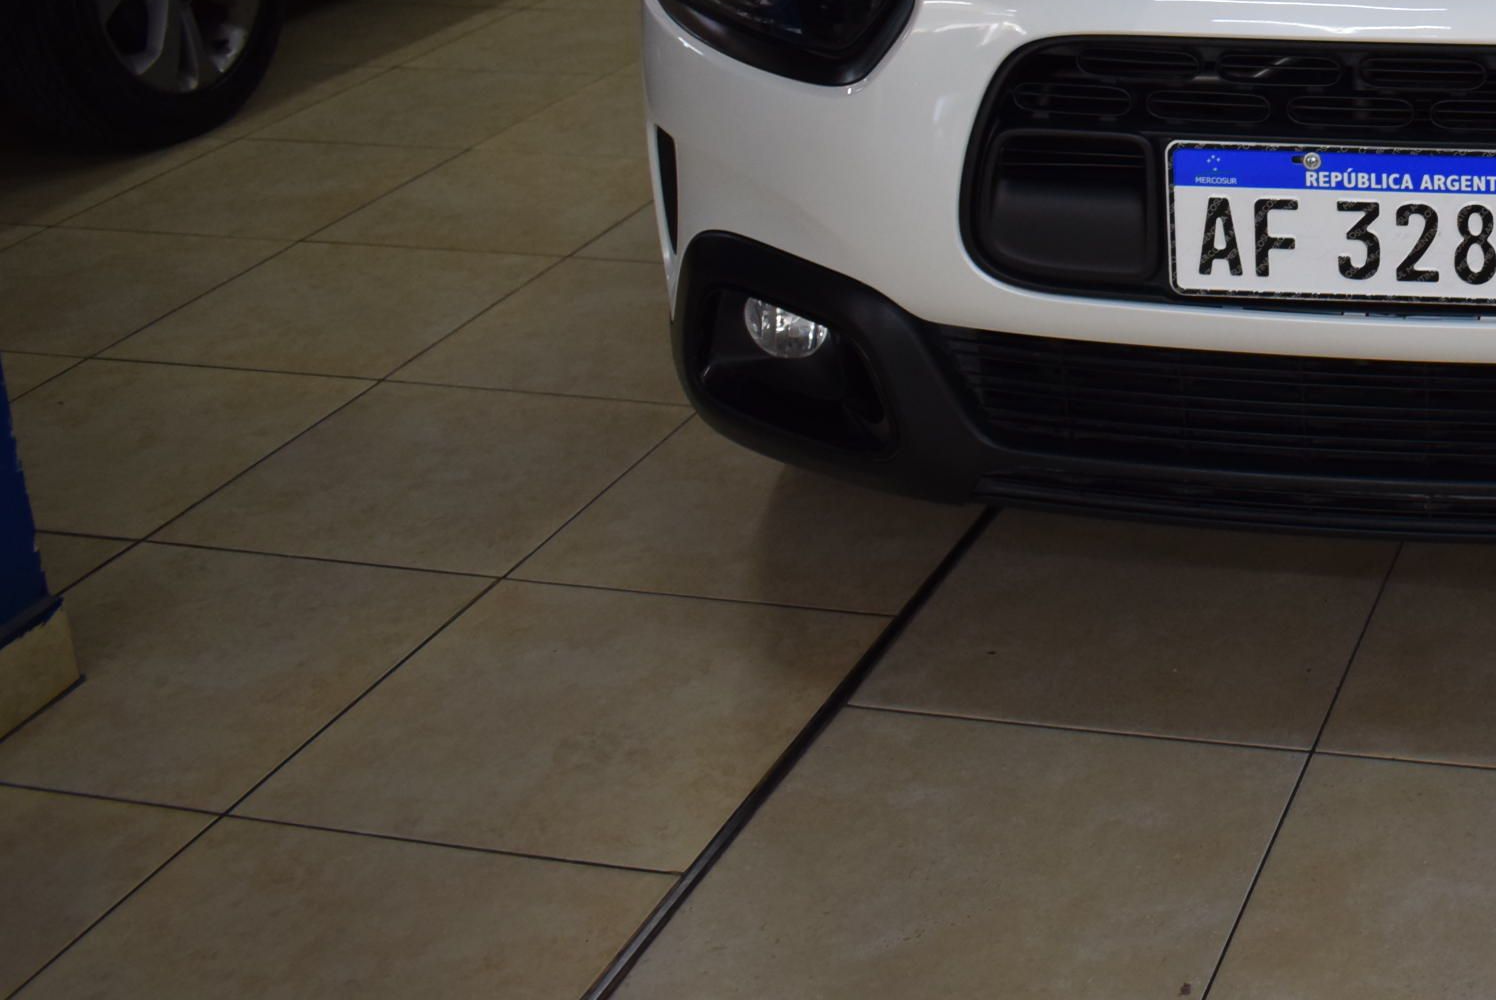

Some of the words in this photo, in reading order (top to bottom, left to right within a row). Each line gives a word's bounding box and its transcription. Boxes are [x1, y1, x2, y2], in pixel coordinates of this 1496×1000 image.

[1195, 176, 1237, 184] MERCOSUR
[1305, 168, 1413, 190] REPÚBLICA
[1199, 197, 1298, 277] AF
[1337, 201, 1496, 285] 328
